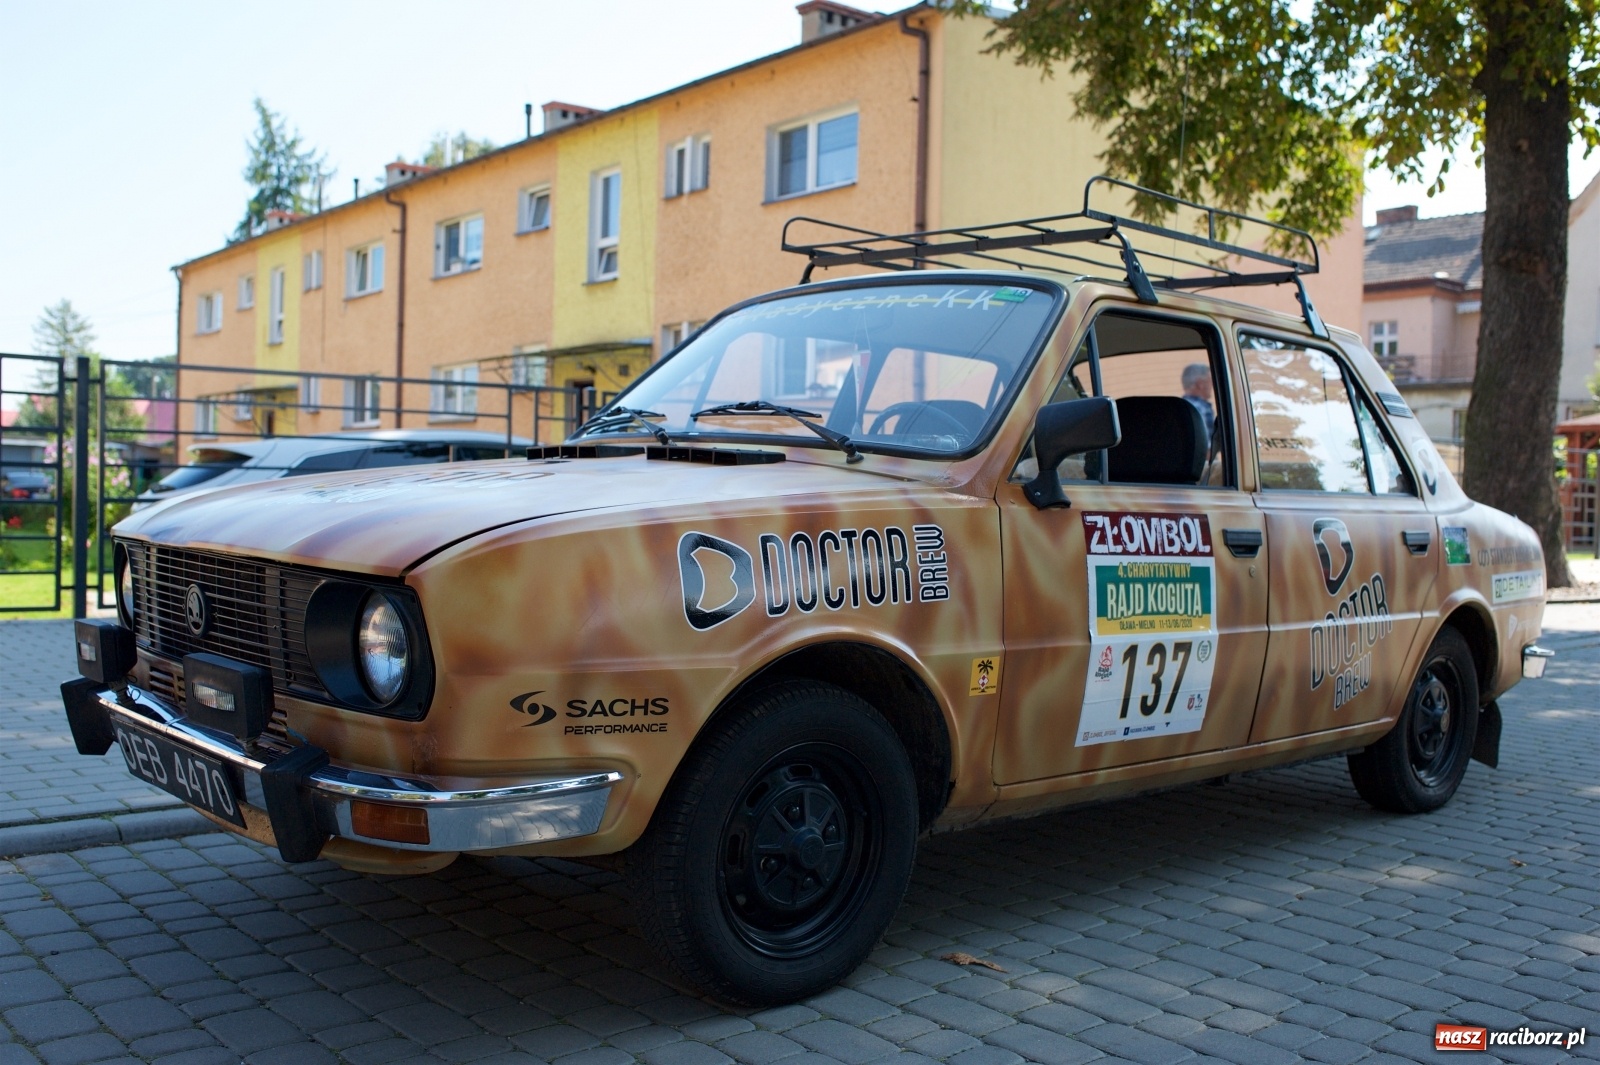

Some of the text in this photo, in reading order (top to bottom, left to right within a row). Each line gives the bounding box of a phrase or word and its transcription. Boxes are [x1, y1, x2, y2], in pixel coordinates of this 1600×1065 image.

[913, 524, 950, 603] BREW
[1084, 515, 1211, 555] ZŁOMBOL
[758, 526, 912, 618] DOCTOR
[1128, 562, 1192, 578] CHARYTATYWNY
[1107, 582, 1203, 620] RAJD KOGUTA
[1310, 572, 1393, 691] DOCTOR
[565, 698, 670, 718] SACHS
[1119, 641, 1193, 719] 137
[1334, 651, 1372, 711] BREW
[564, 723, 668, 736] PERFORMANCE
[174, 751, 234, 817] 4470
